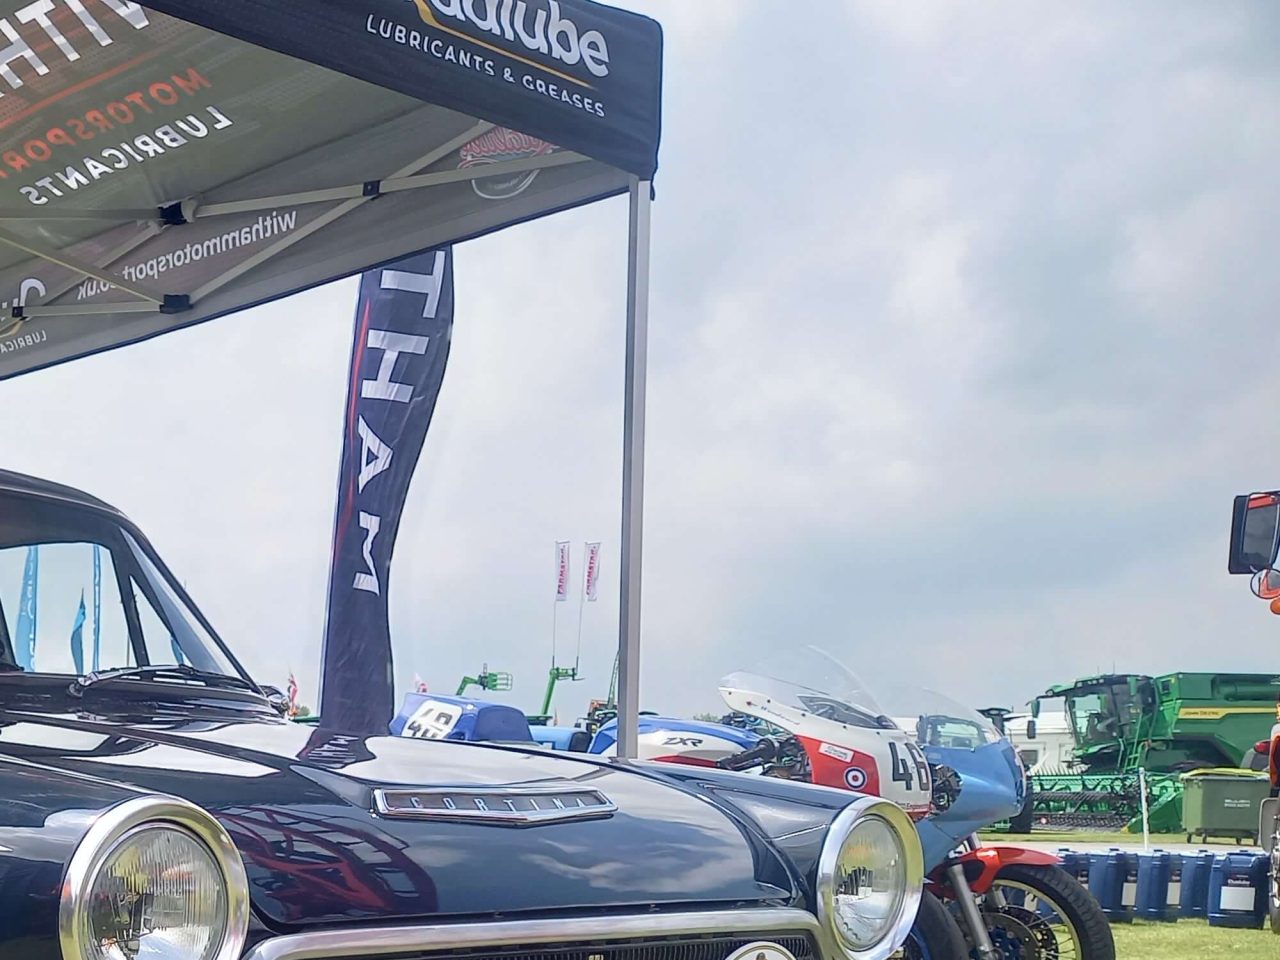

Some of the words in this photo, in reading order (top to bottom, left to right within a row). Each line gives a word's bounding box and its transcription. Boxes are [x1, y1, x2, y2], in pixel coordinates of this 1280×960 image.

[366, 13, 496, 77] LUBRICANTS
[503, 67, 516, 84] &
[521, 74, 607, 119] GREASES
[662, 737, 704, 747] ZXR
[888, 742, 930, 791] 46
[410, 797, 586, 813] CORTINA
